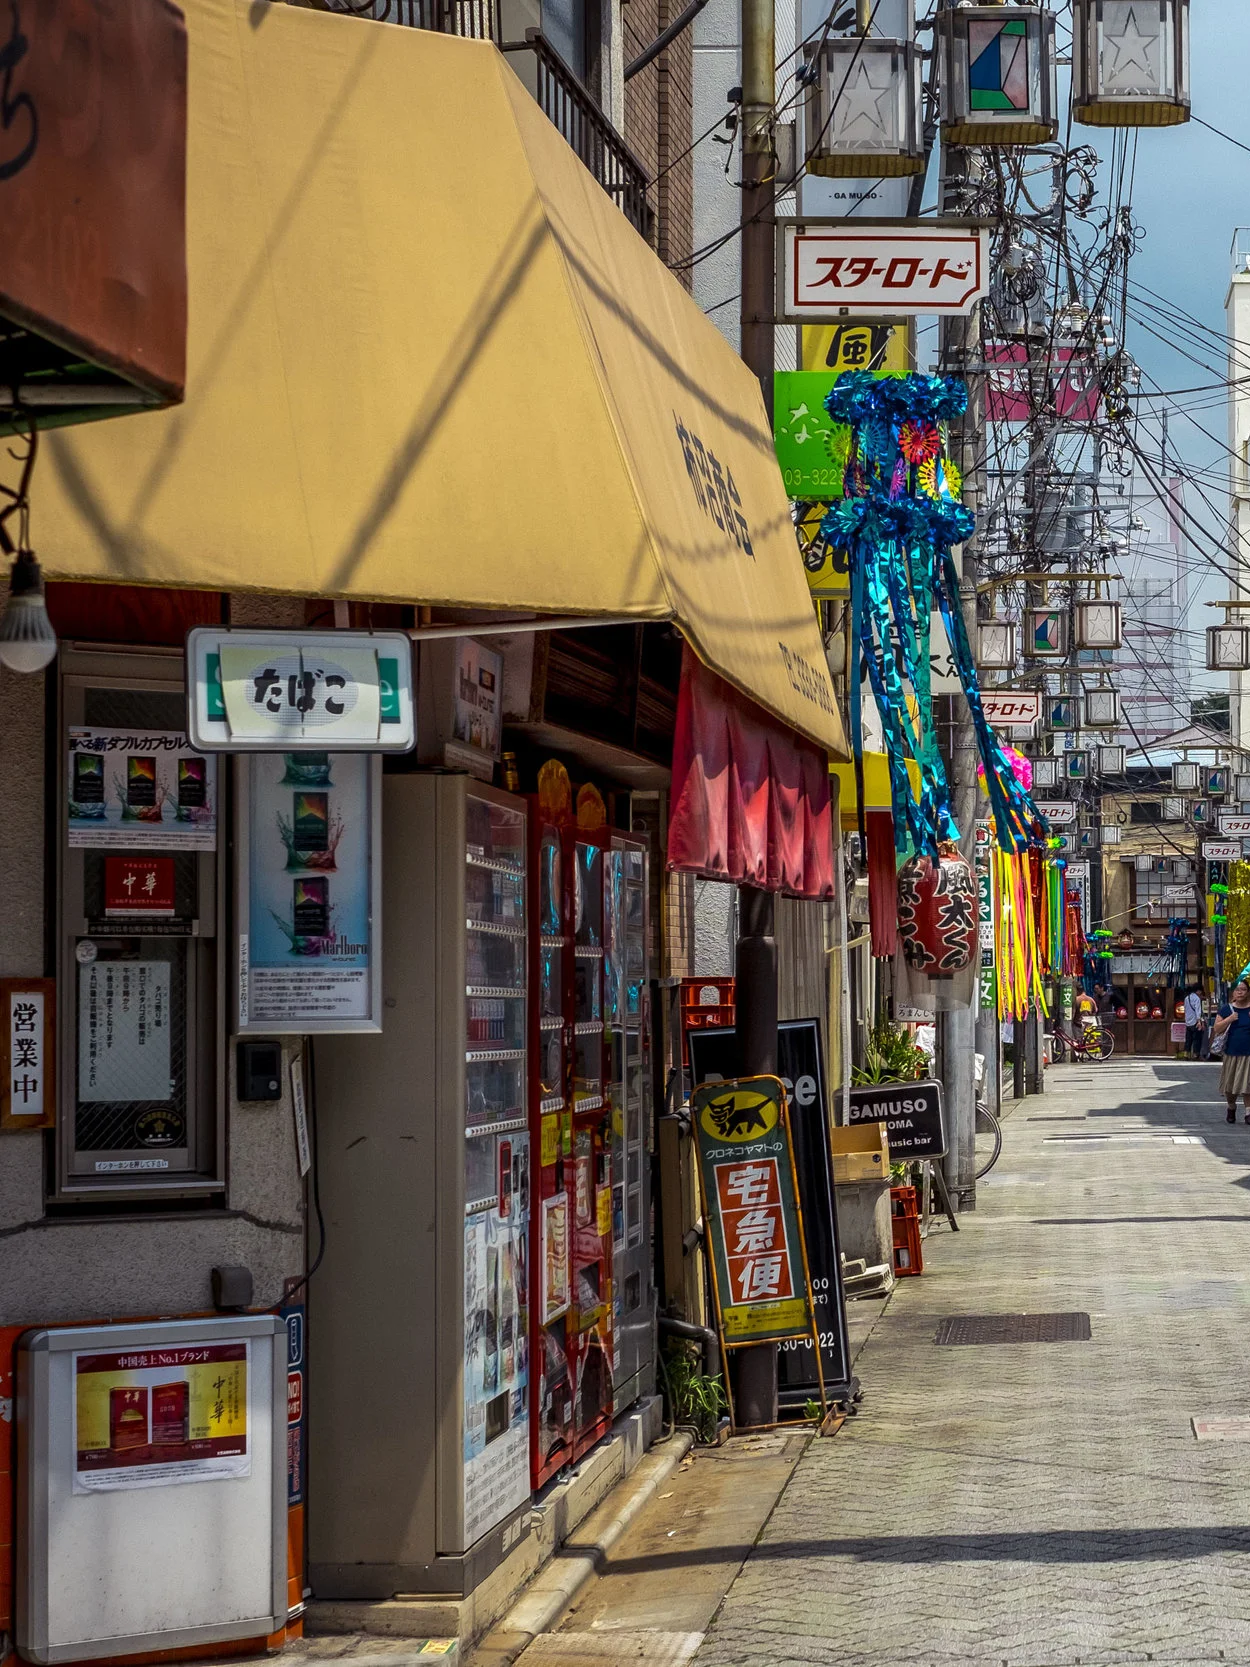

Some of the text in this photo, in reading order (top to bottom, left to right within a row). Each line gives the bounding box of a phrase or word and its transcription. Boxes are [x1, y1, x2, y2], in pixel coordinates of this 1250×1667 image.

[834, 191, 846, 200] GA
[806, 257, 973, 289] スターロード
[254, 668, 346, 716] たばこ
[982, 703, 1034, 716] ターロード
[1040, 808, 1071, 817] ターロード
[122, 871, 157, 896] 中華
[936, 863, 975, 969] 風太くん
[320, 935, 368, 955] Marlboro
[12, 1002, 39, 1105] 営業中
[849, 1099, 928, 1119] GAMUSO
[914, 1136, 932, 1146] bar
[705, 1143, 783, 1160] クロネコヤマトの
[727, 1165, 782, 1300] 宅急便
